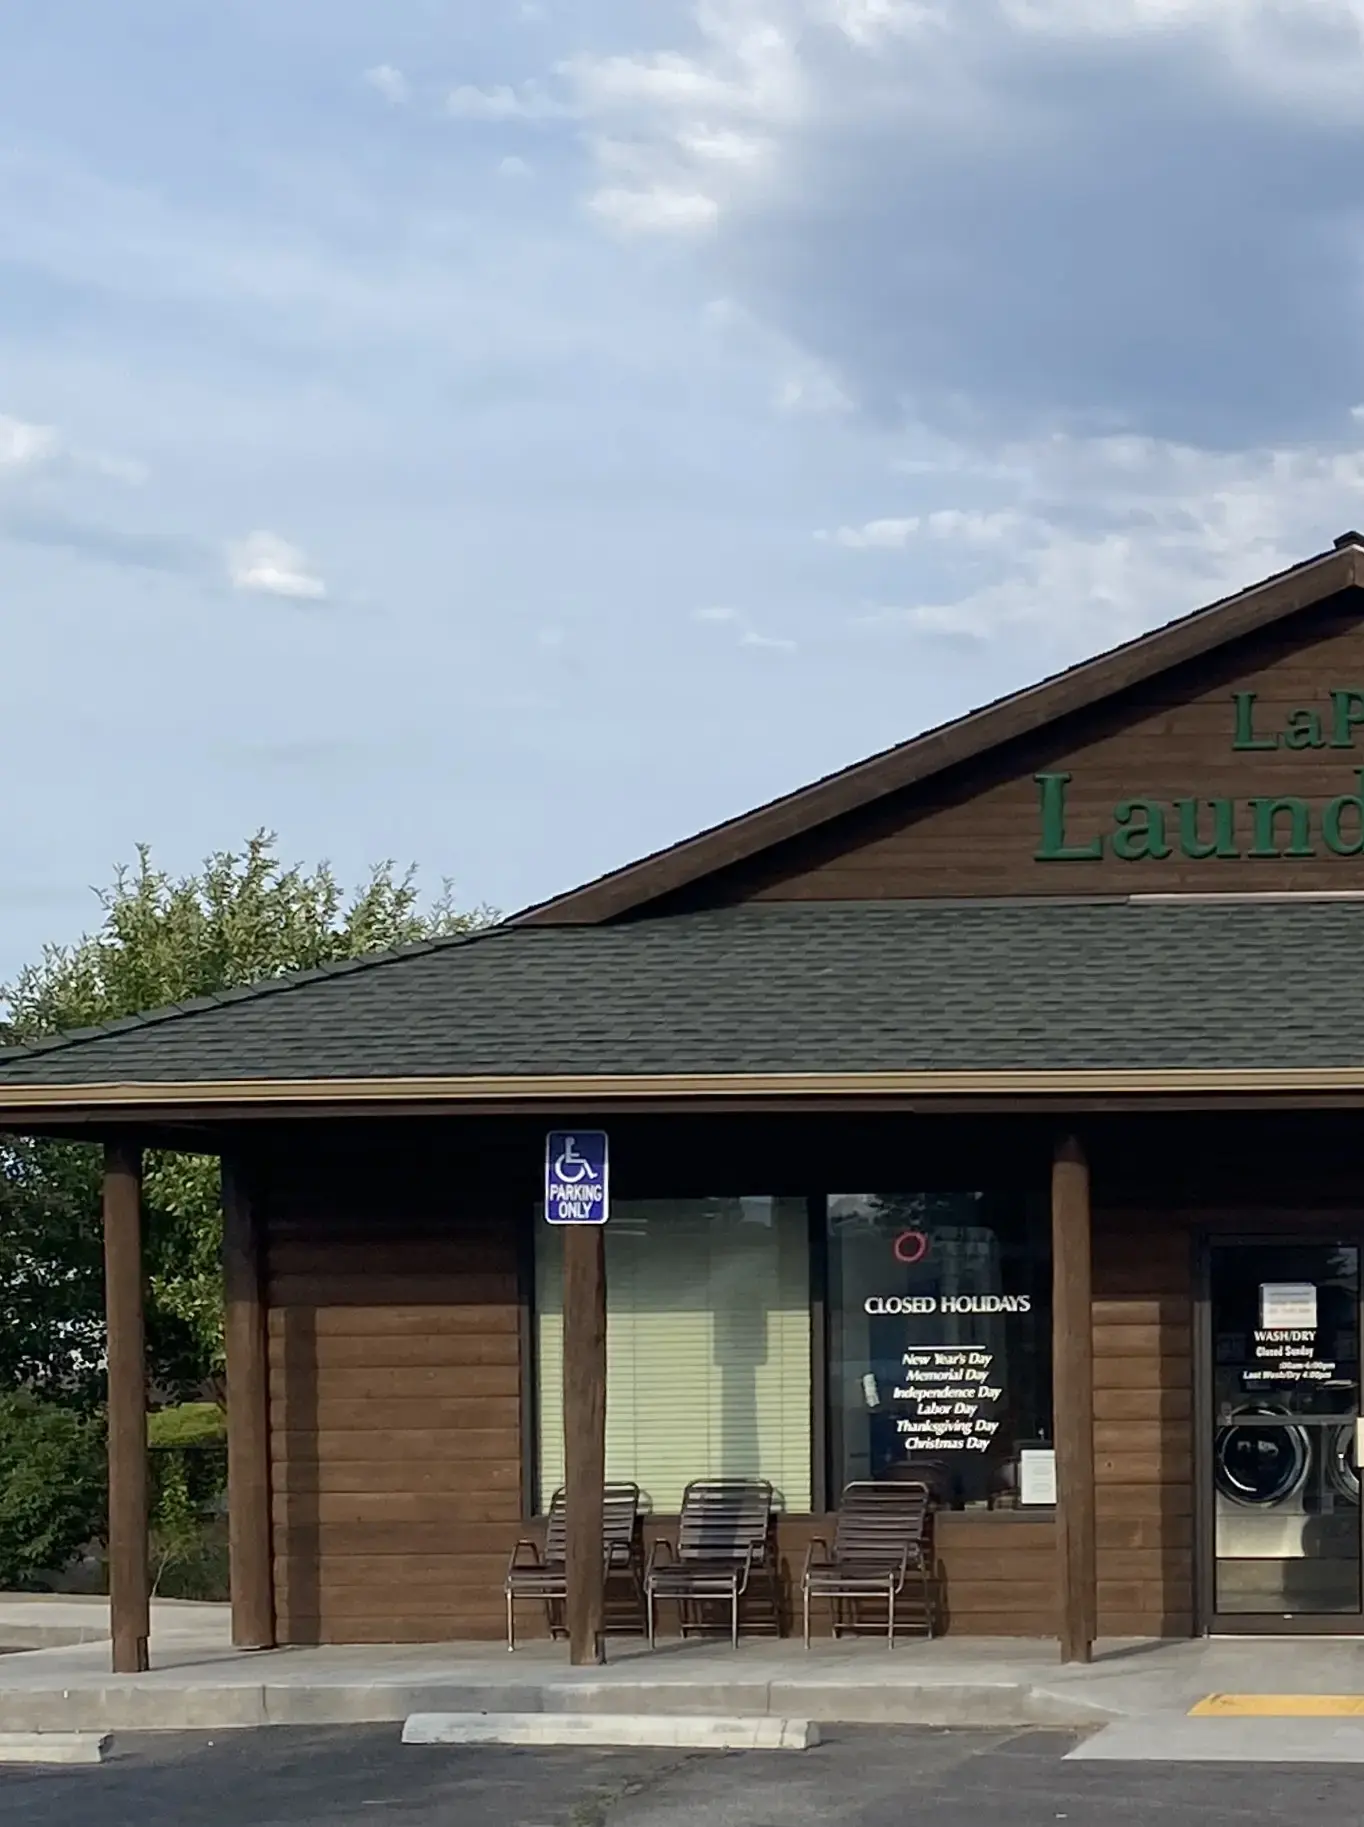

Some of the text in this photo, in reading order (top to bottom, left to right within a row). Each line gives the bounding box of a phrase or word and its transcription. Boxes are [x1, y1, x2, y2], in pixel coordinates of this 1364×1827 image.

[549, 1184, 603, 1201] PARKING
[558, 1201, 593, 1219] ONLY
[864, 1295, 1031, 1314] CLOSED HOLIDAYS
[1253, 1330, 1317, 1342] WASH/DRY
[1255, 1344, 1314, 1358] Closed Sunday
[902, 1352, 993, 1368] New Year's Day
[905, 1368, 989, 1384] Memorial Day
[893, 1385, 1002, 1401] Independence Day
[917, 1402, 978, 1418] Labor Day
[896, 1419, 999, 1436] Thanksgiving Day
[905, 1436, 990, 1452] Christmas Day
